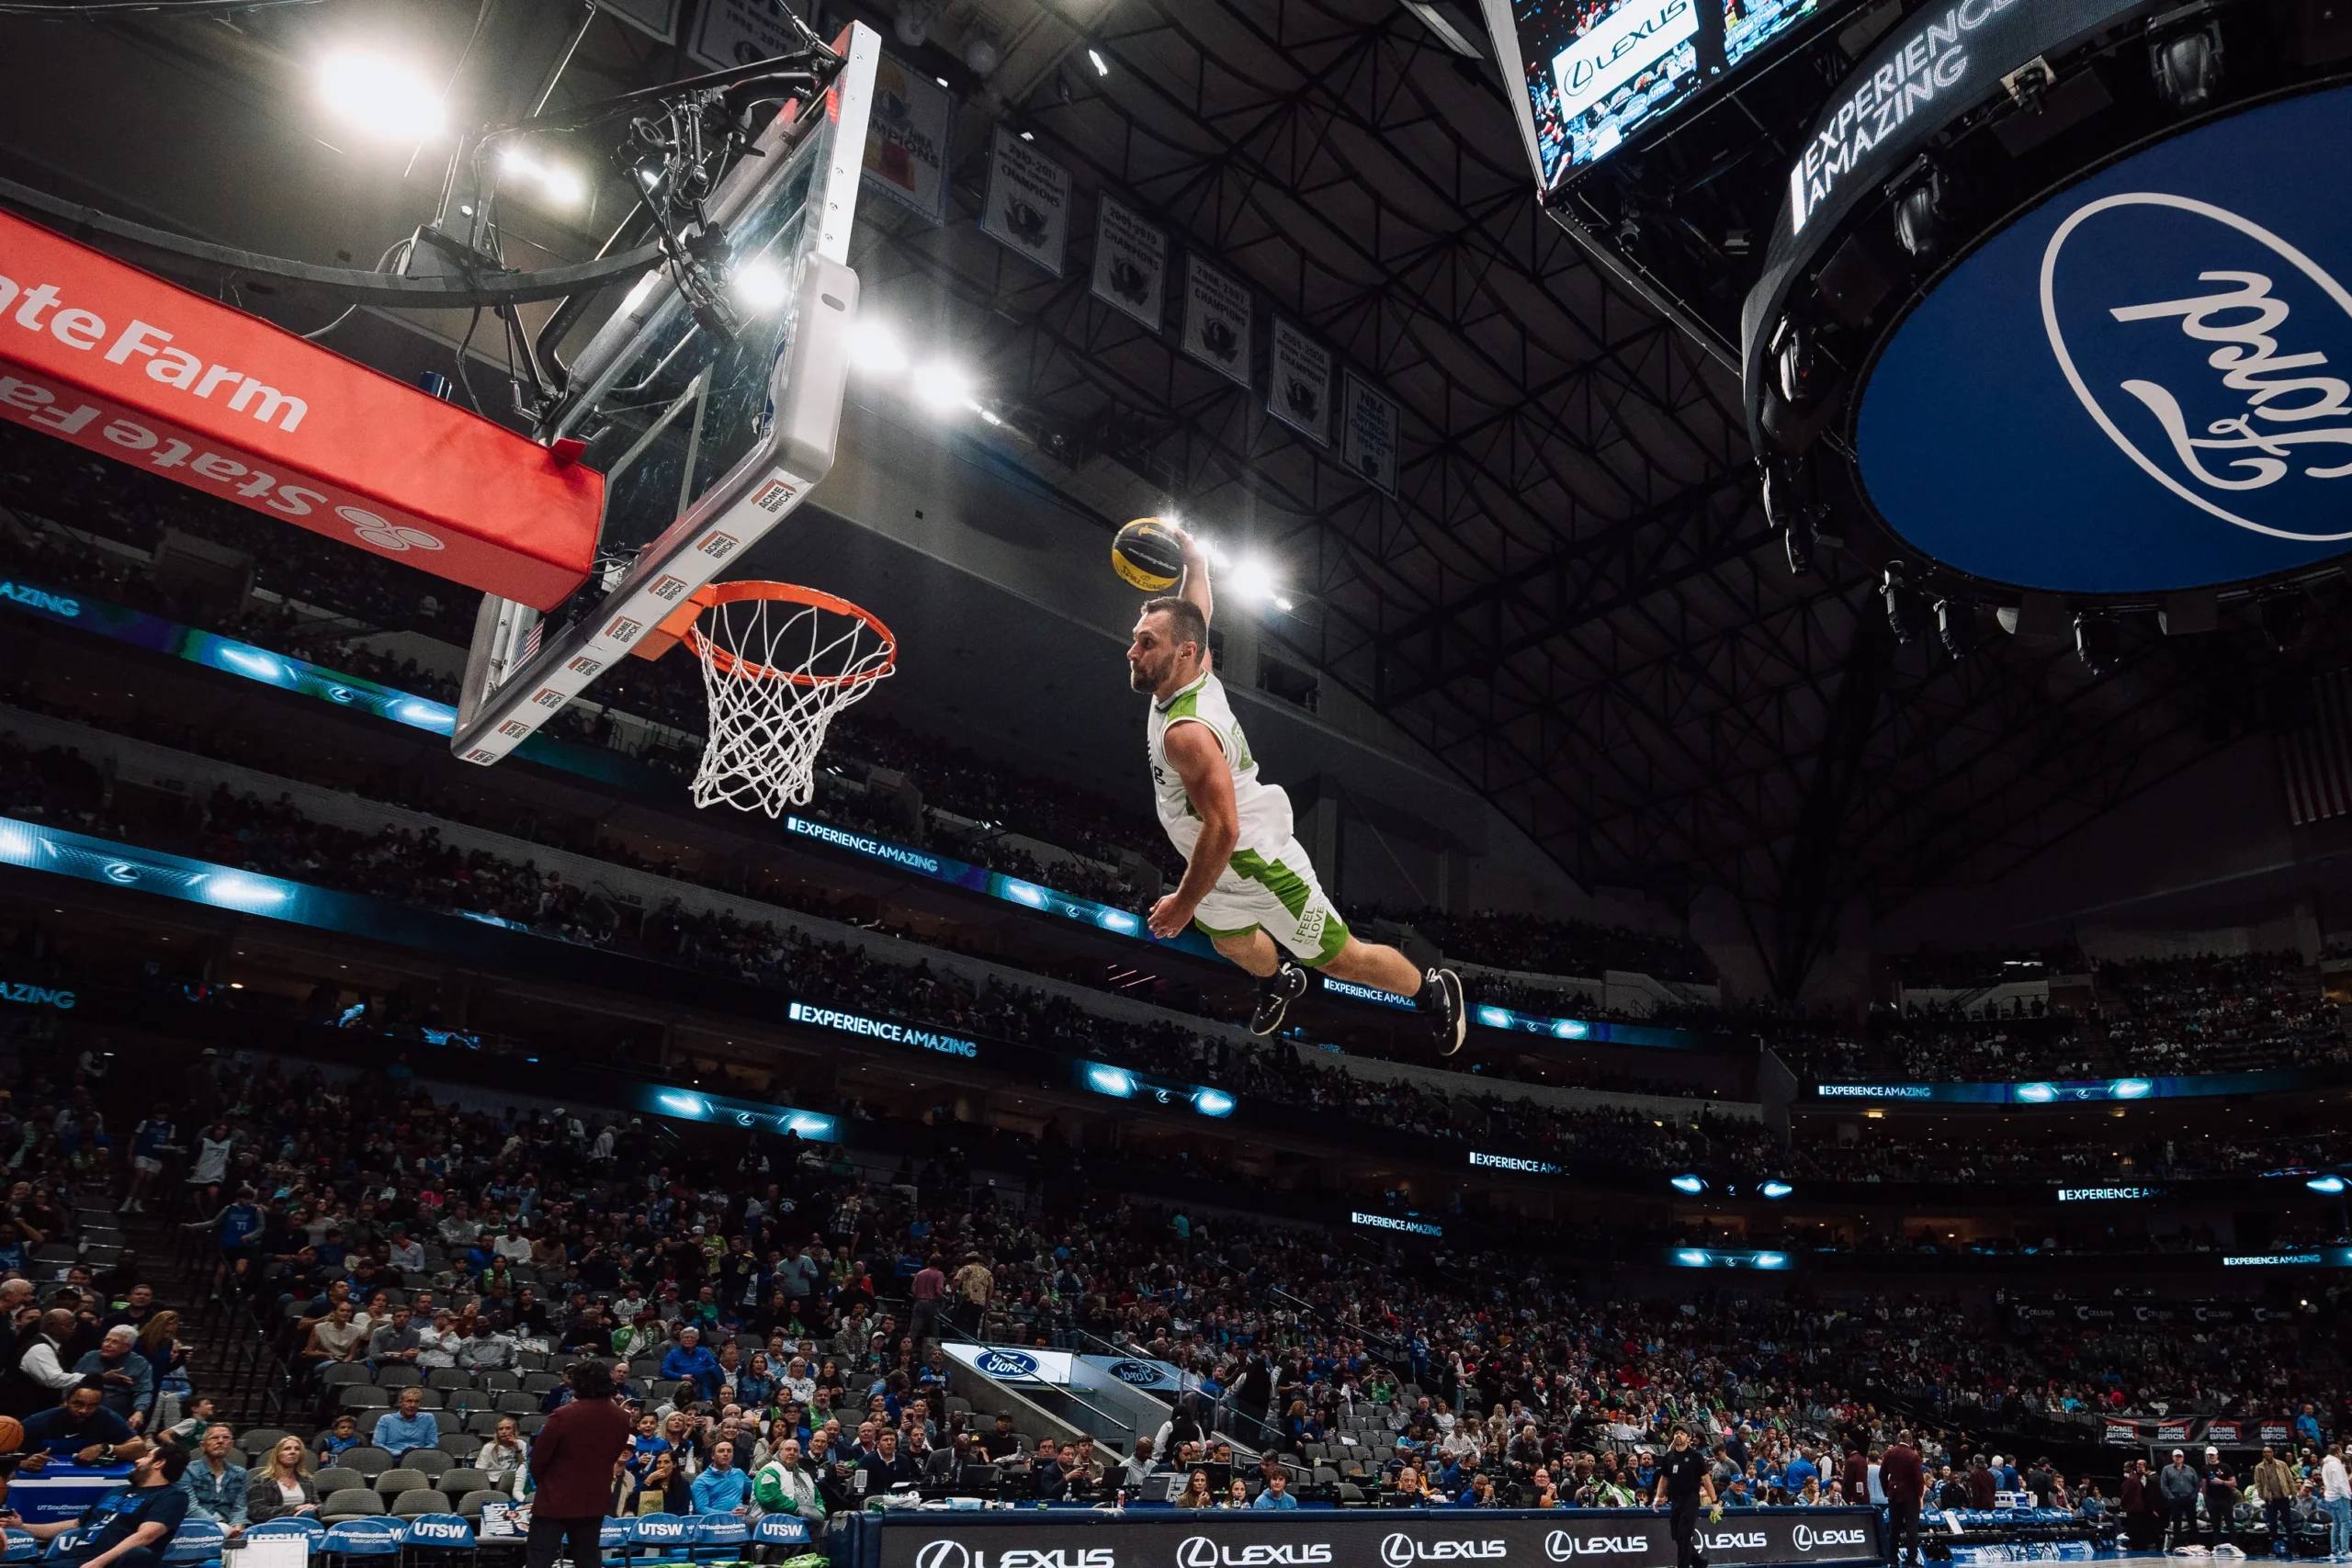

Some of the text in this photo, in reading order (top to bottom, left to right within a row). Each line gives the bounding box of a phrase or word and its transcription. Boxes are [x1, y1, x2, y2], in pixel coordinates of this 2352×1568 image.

[1597, 0, 1687, 70] LEXUS
[1808, 45, 1968, 216] AMAZING
[104, 319, 308, 433] Farm
[2109, 270, 2352, 491] Ford
[102, 419, 328, 515] State
[759, 486, 785, 511] ACME
[767, 491, 796, 514] BRICK
[705, 536, 728, 557] ACME
[712, 538, 738, 559] BRICK
[655, 579, 677, 600] ACME
[662, 582, 686, 602] BRICK
[612, 619, 633, 641] ACME
[620, 622, 640, 644] BRICK
[575, 659, 593, 675] ACME
[582, 661, 601, 677] BRICK
[539, 691, 556, 705] ACME
[547, 694, 564, 709] BRICK
[506, 722, 522, 737] ACME
[513, 724, 531, 740] BRICK
[797, 819, 939, 873] EXPERIENCE AMAZING
[1295, 908, 1316, 936] FEEL
[1329, 981, 1384, 1001] EXPERIENCE
[801, 1005, 978, 1058] EXPERIENCE AMAZING
[1825, 1085, 1931, 1097] EXPERIENCE AMAZING
[1476, 1153, 1539, 1173] EXPERIENCE
[2065, 1187, 2141, 1201] EXPERIENCE
[1357, 1213, 1442, 1237] EXPERIENCE AMAZING
[2228, 1253, 2322, 1266] EXPERIENCE AMAZING
[986, 1353, 1027, 1374] Ford
[414, 1521, 468, 1539] UTSW
[639, 1523, 684, 1536] UTSW
[763, 1523, 803, 1537] UTSW
[1813, 1529, 1865, 1546] LEXUS
[1417, 1538, 1507, 1560] LEXUS
[1573, 1535, 1648, 1554] LEXUS
[1705, 1531, 1767, 1550] LEXUS
[975, 1548, 1114, 1568] LEXUS
[1222, 1543, 1332, 1566] LEXUS
